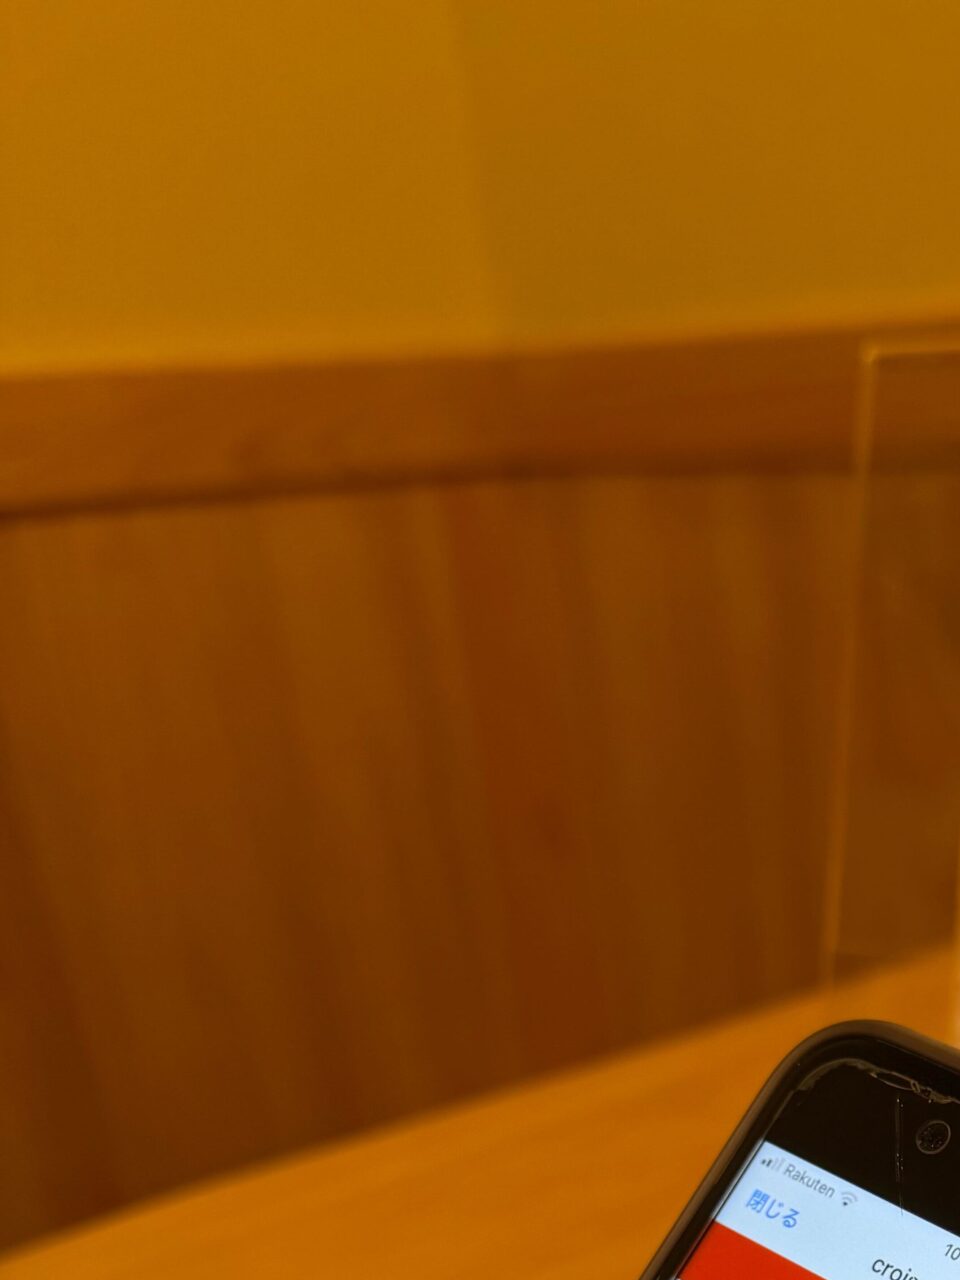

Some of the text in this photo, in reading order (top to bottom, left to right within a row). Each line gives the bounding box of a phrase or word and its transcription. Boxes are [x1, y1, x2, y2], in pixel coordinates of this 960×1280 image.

[784, 1163, 836, 1199] Rakuten
[746, 1188, 801, 1229] 閉じる
